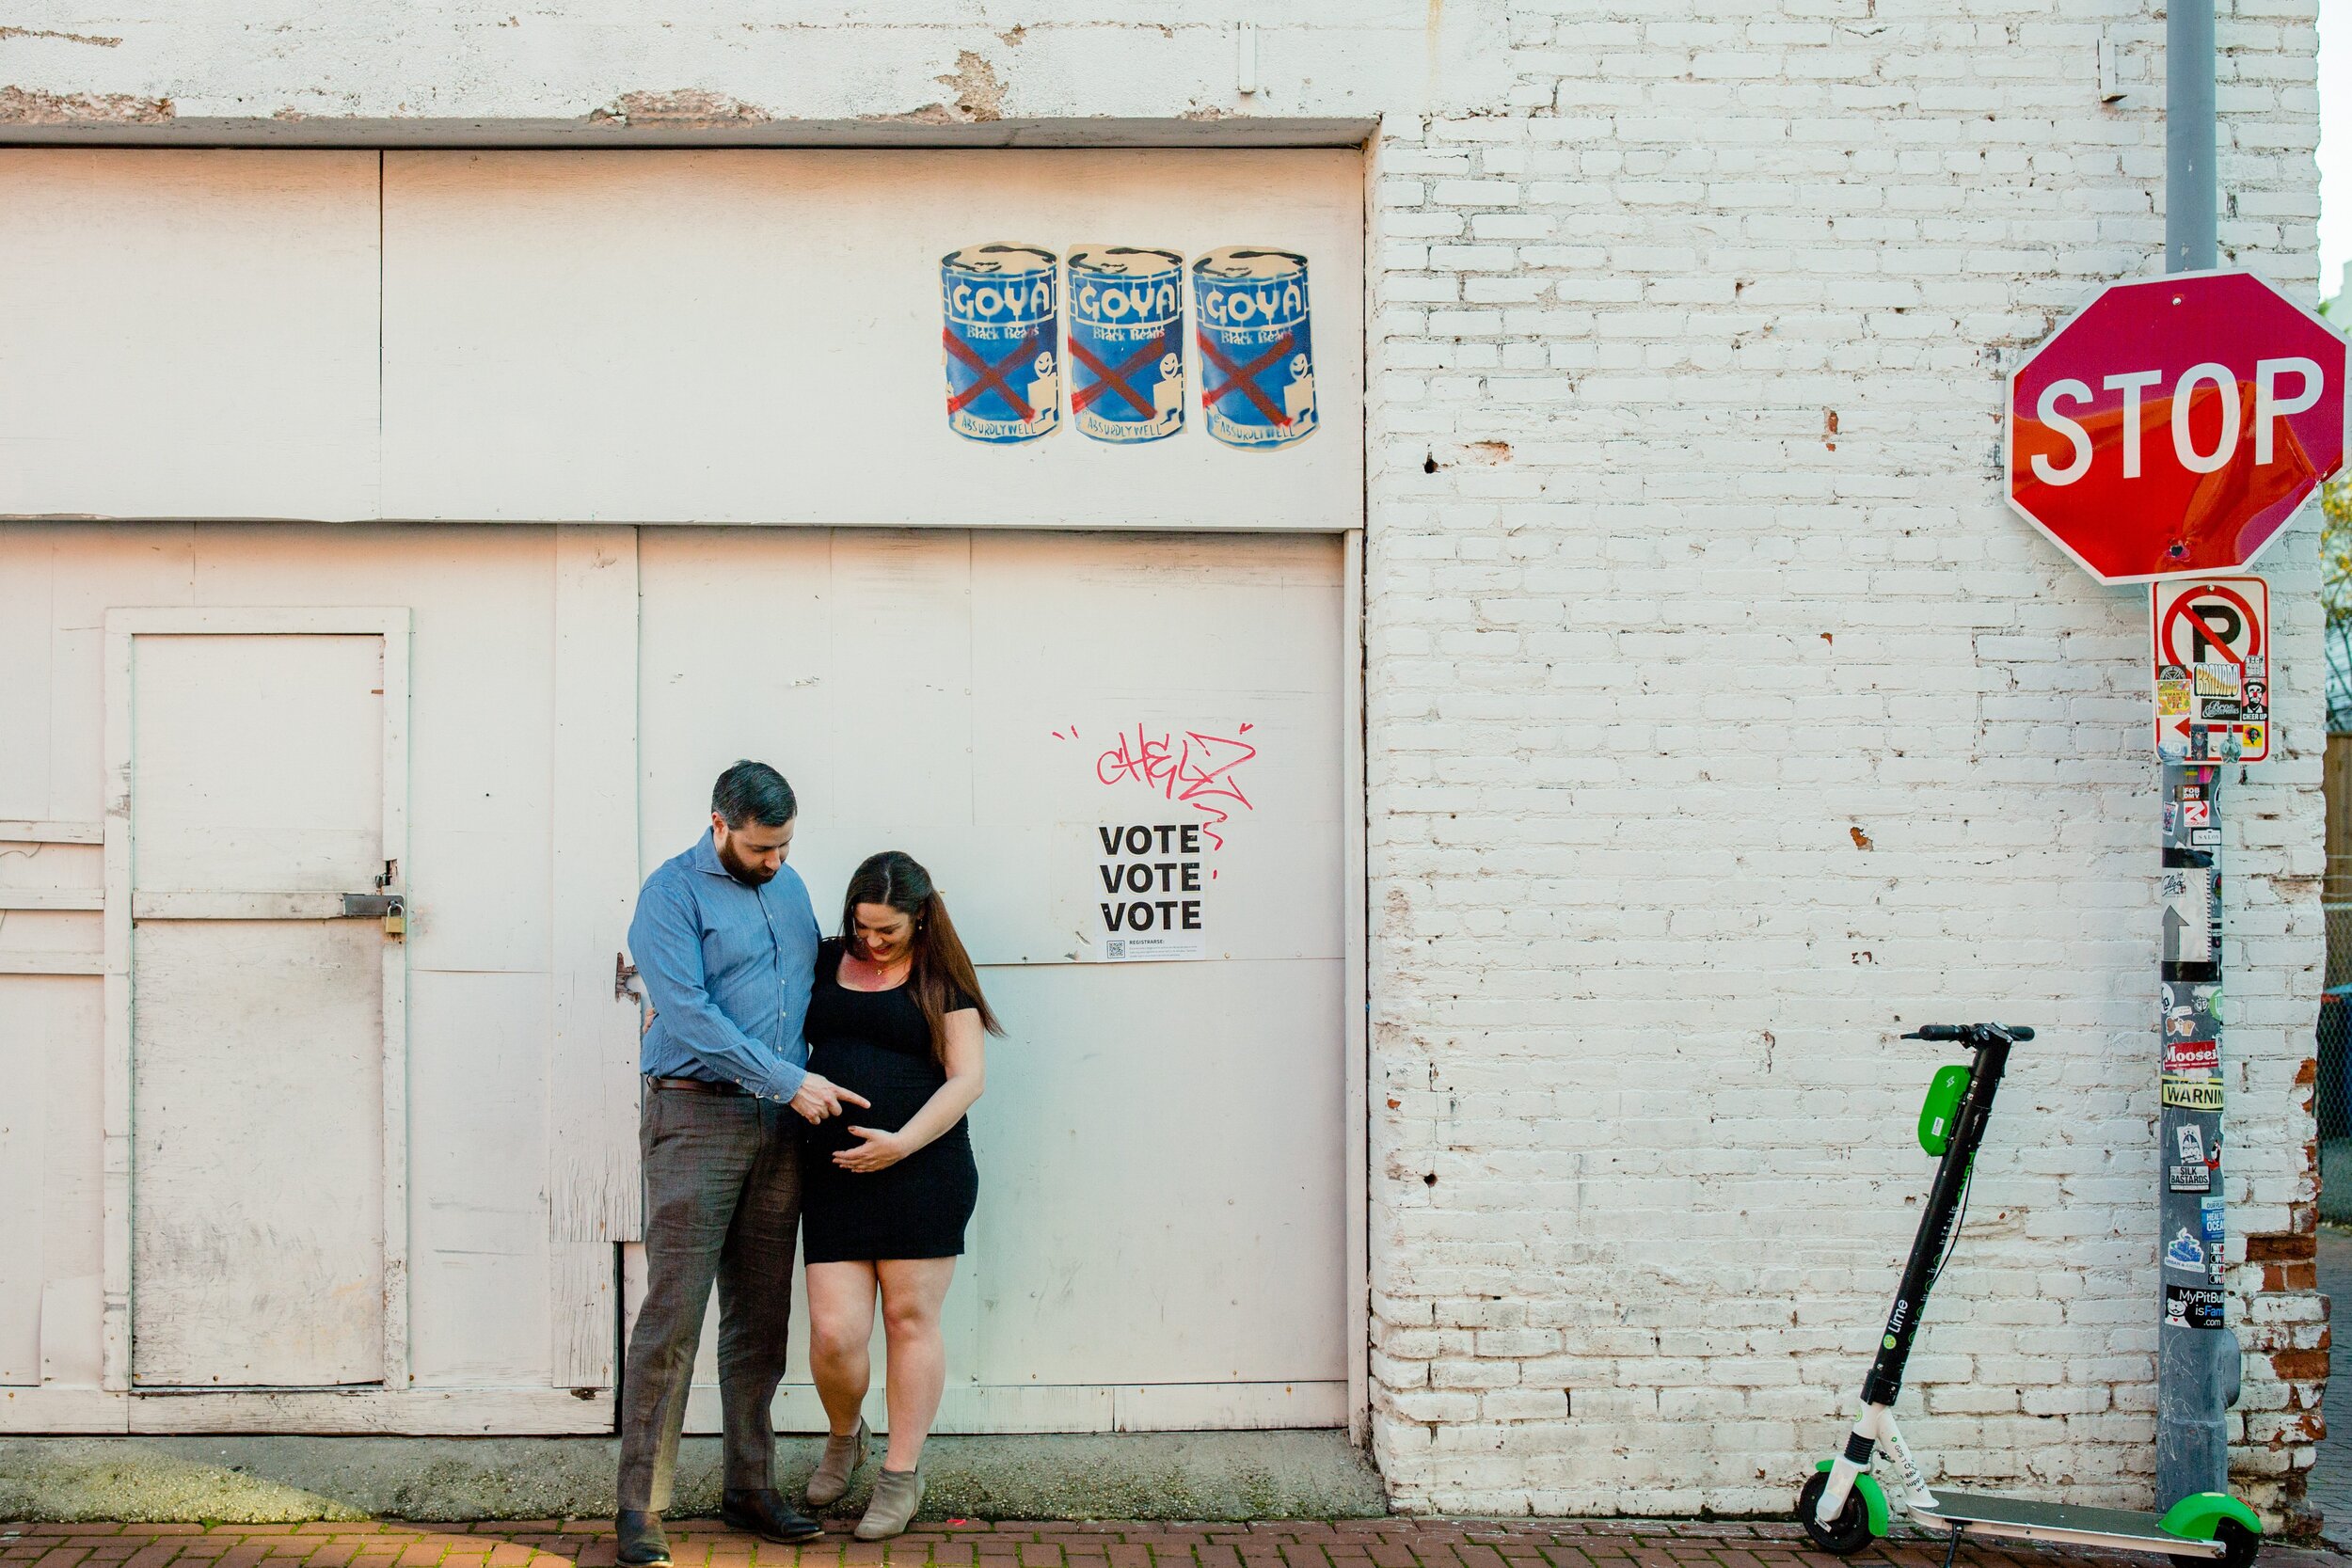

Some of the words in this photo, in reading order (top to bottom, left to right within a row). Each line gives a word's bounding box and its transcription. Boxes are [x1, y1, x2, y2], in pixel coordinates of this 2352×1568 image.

[953, 282, 1049, 319] GOYA
[1079, 284, 1175, 320] GOYA
[1206, 285, 1301, 324] GOYA
[967, 325, 999, 340] Black
[1093, 326, 1125, 341] Black
[1130, 327, 1165, 341] Beans
[1221, 331, 1253, 344] Black
[2030, 356, 2325, 486] STOP
[1099, 824, 1200, 855] VOTE
[1099, 863, 1201, 894] VOTE
[1100, 900, 1202, 932] VOTE
[2170, 1175, 2208, 1184] BASTARDS
[2180, 1166, 2197, 1176] SILK
[1887, 1299, 1908, 1334] Lime
